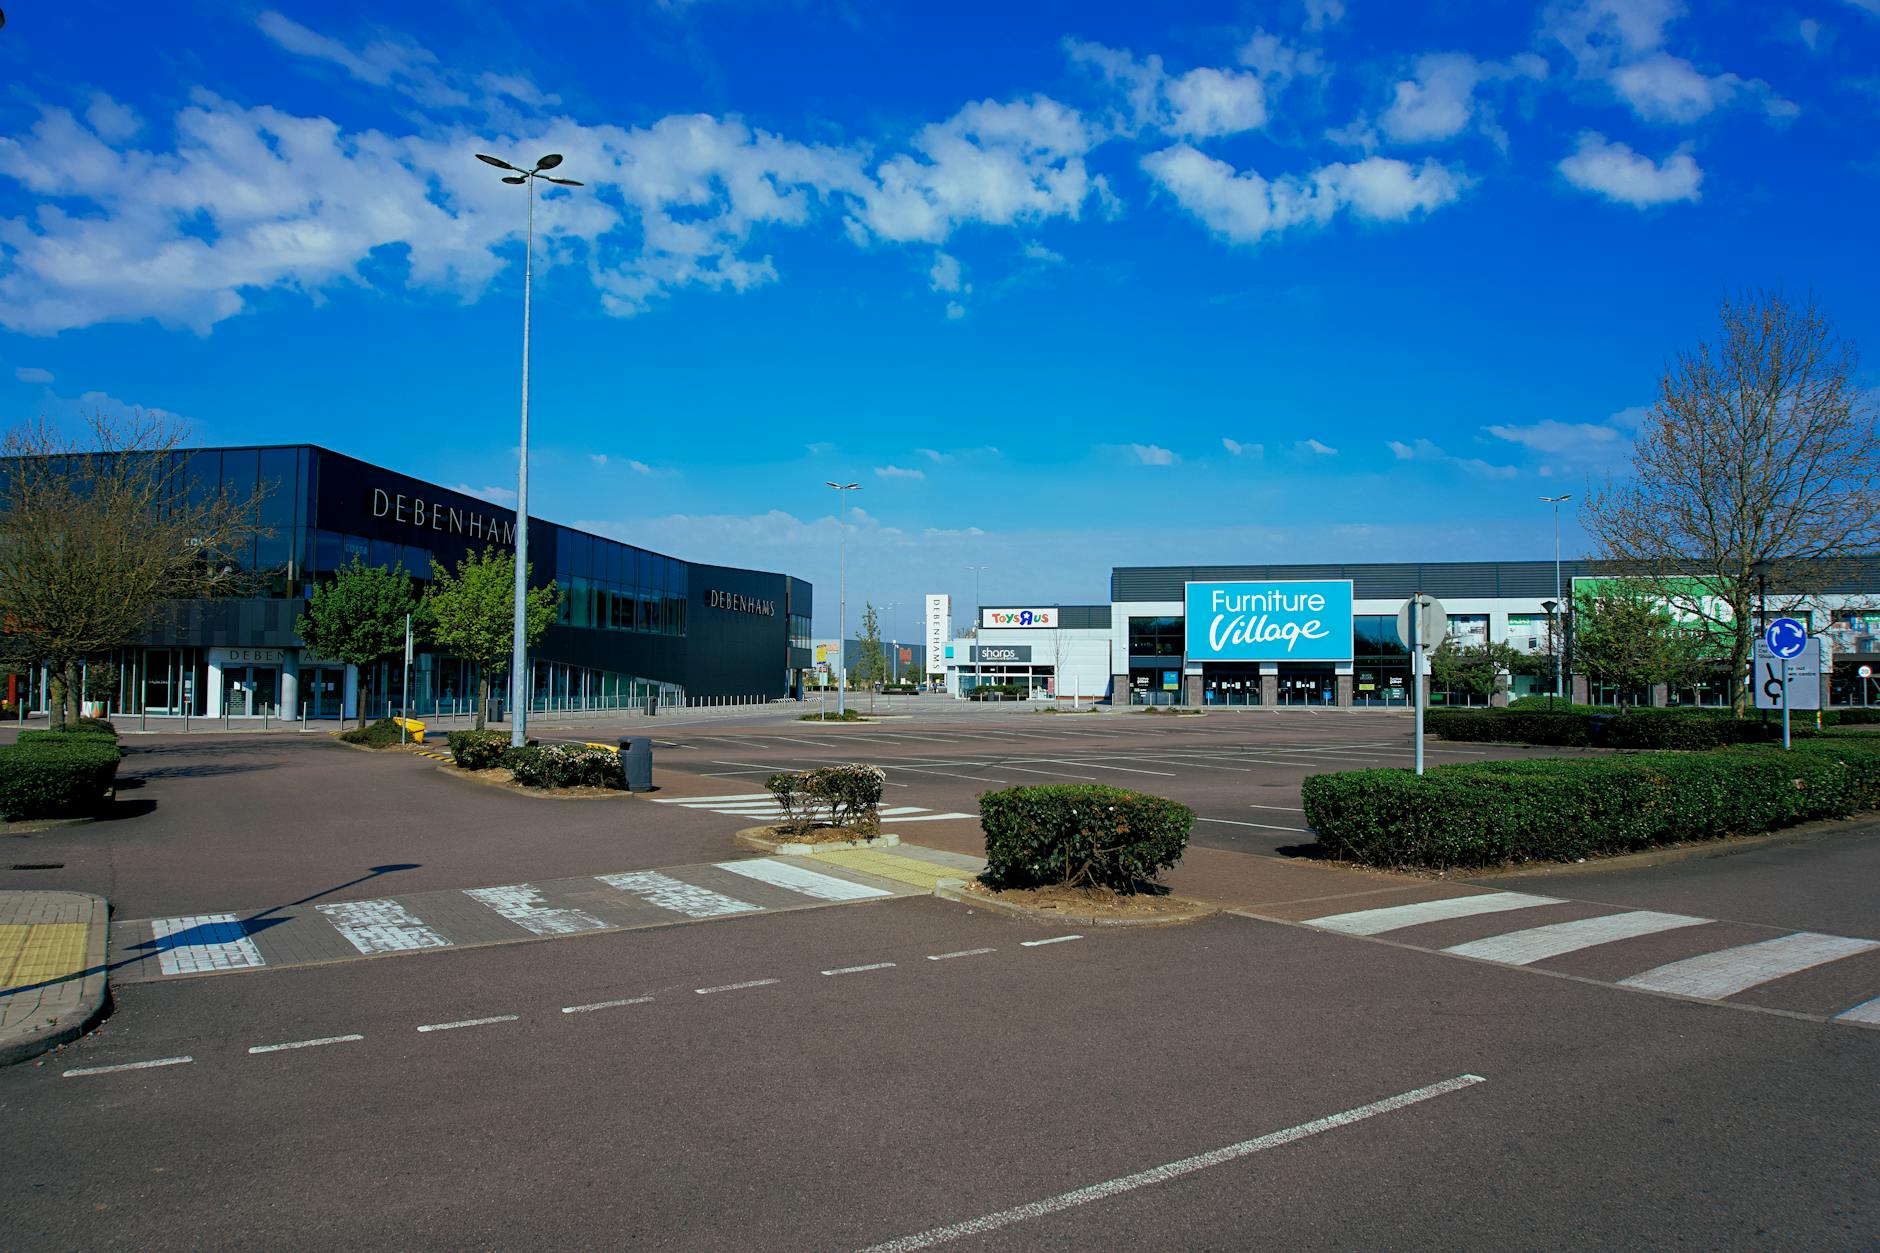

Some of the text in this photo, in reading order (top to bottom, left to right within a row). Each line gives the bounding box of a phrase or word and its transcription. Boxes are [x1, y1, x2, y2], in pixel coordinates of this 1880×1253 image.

[373, 488, 529, 546] DEBENHAM
[711, 590, 775, 617] DEBENHAMS
[1212, 589, 1326, 612] Furniture
[1209, 613, 1330, 652] Village
[981, 647, 1015, 661] sharps
